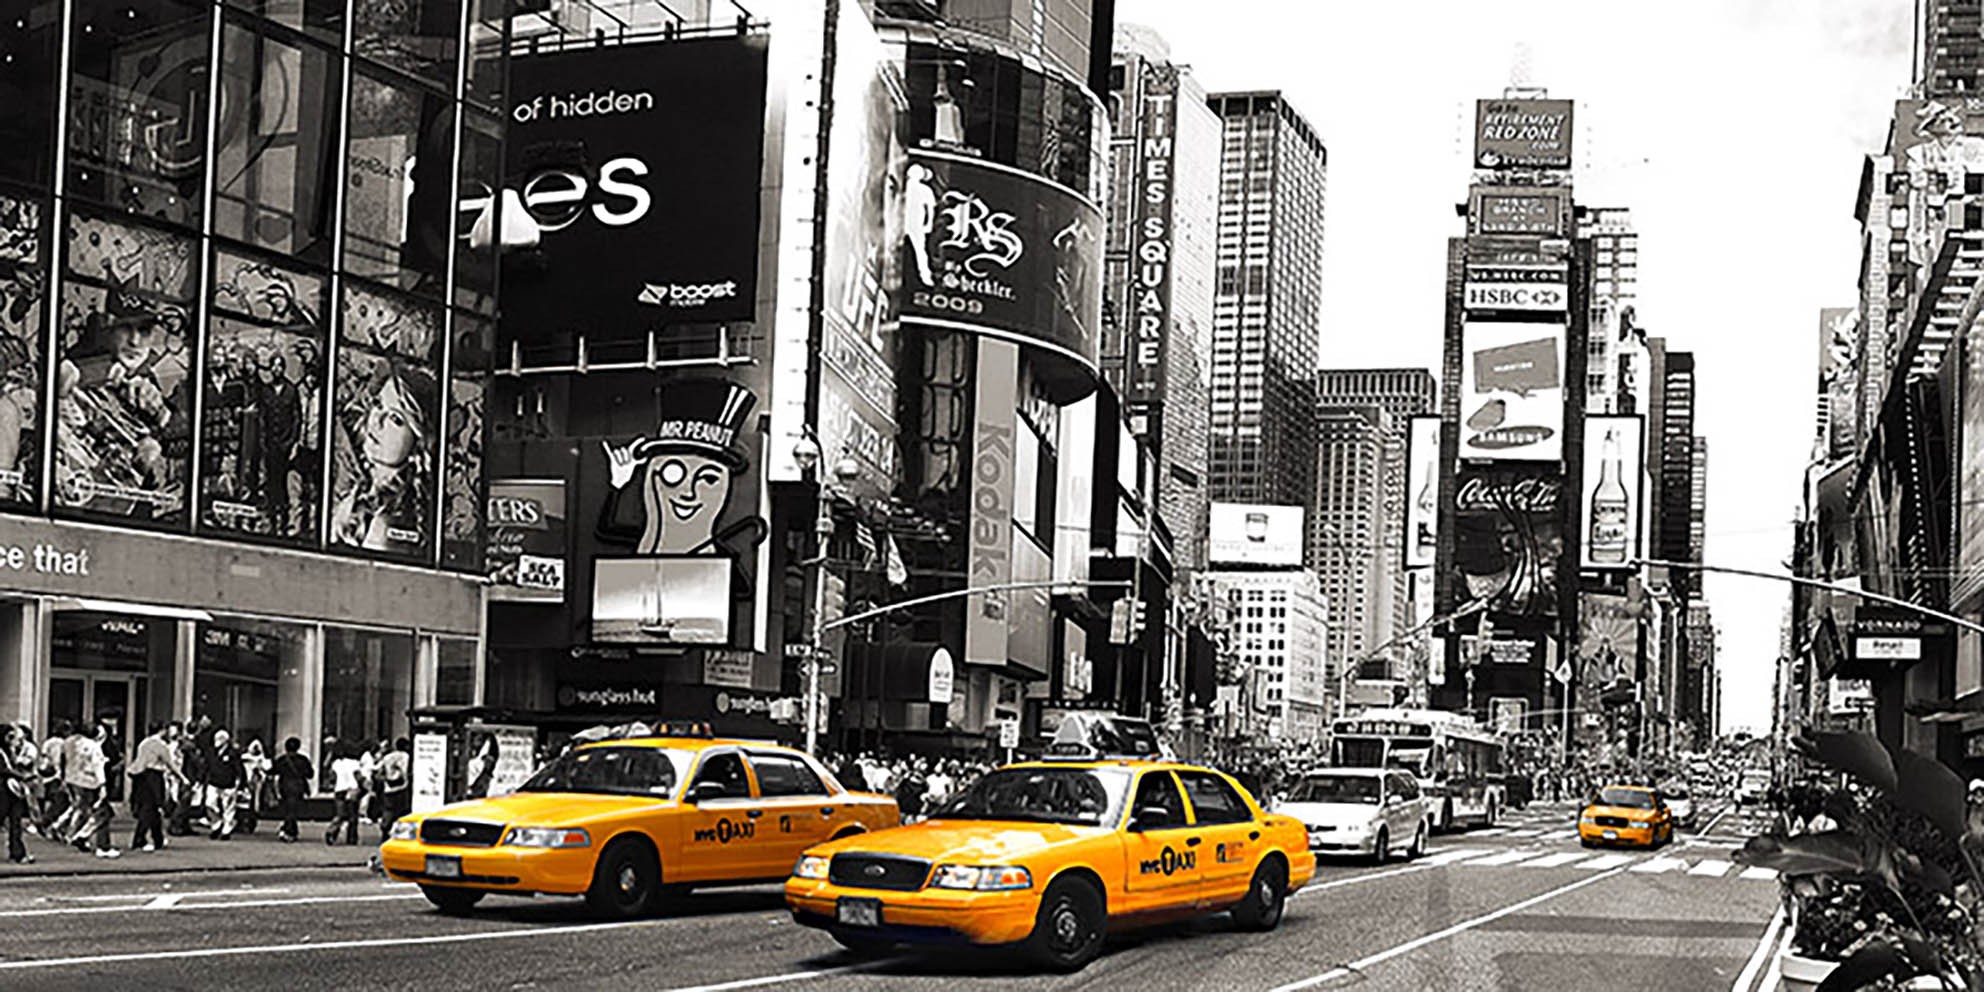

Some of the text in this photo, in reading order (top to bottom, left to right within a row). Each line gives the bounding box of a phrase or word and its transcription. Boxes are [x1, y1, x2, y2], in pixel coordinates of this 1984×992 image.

[513, 90, 653, 122] of hidden
[1138, 94, 1173, 364] TIMES SQUARE
[670, 281, 736, 299] boost
[913, 292, 984, 314] 2009
[1470, 289, 1529, 305] HSBC
[684, 421, 733, 447] PEANUT
[973, 422, 1011, 577] Kodak
[33, 544, 89, 575] that
